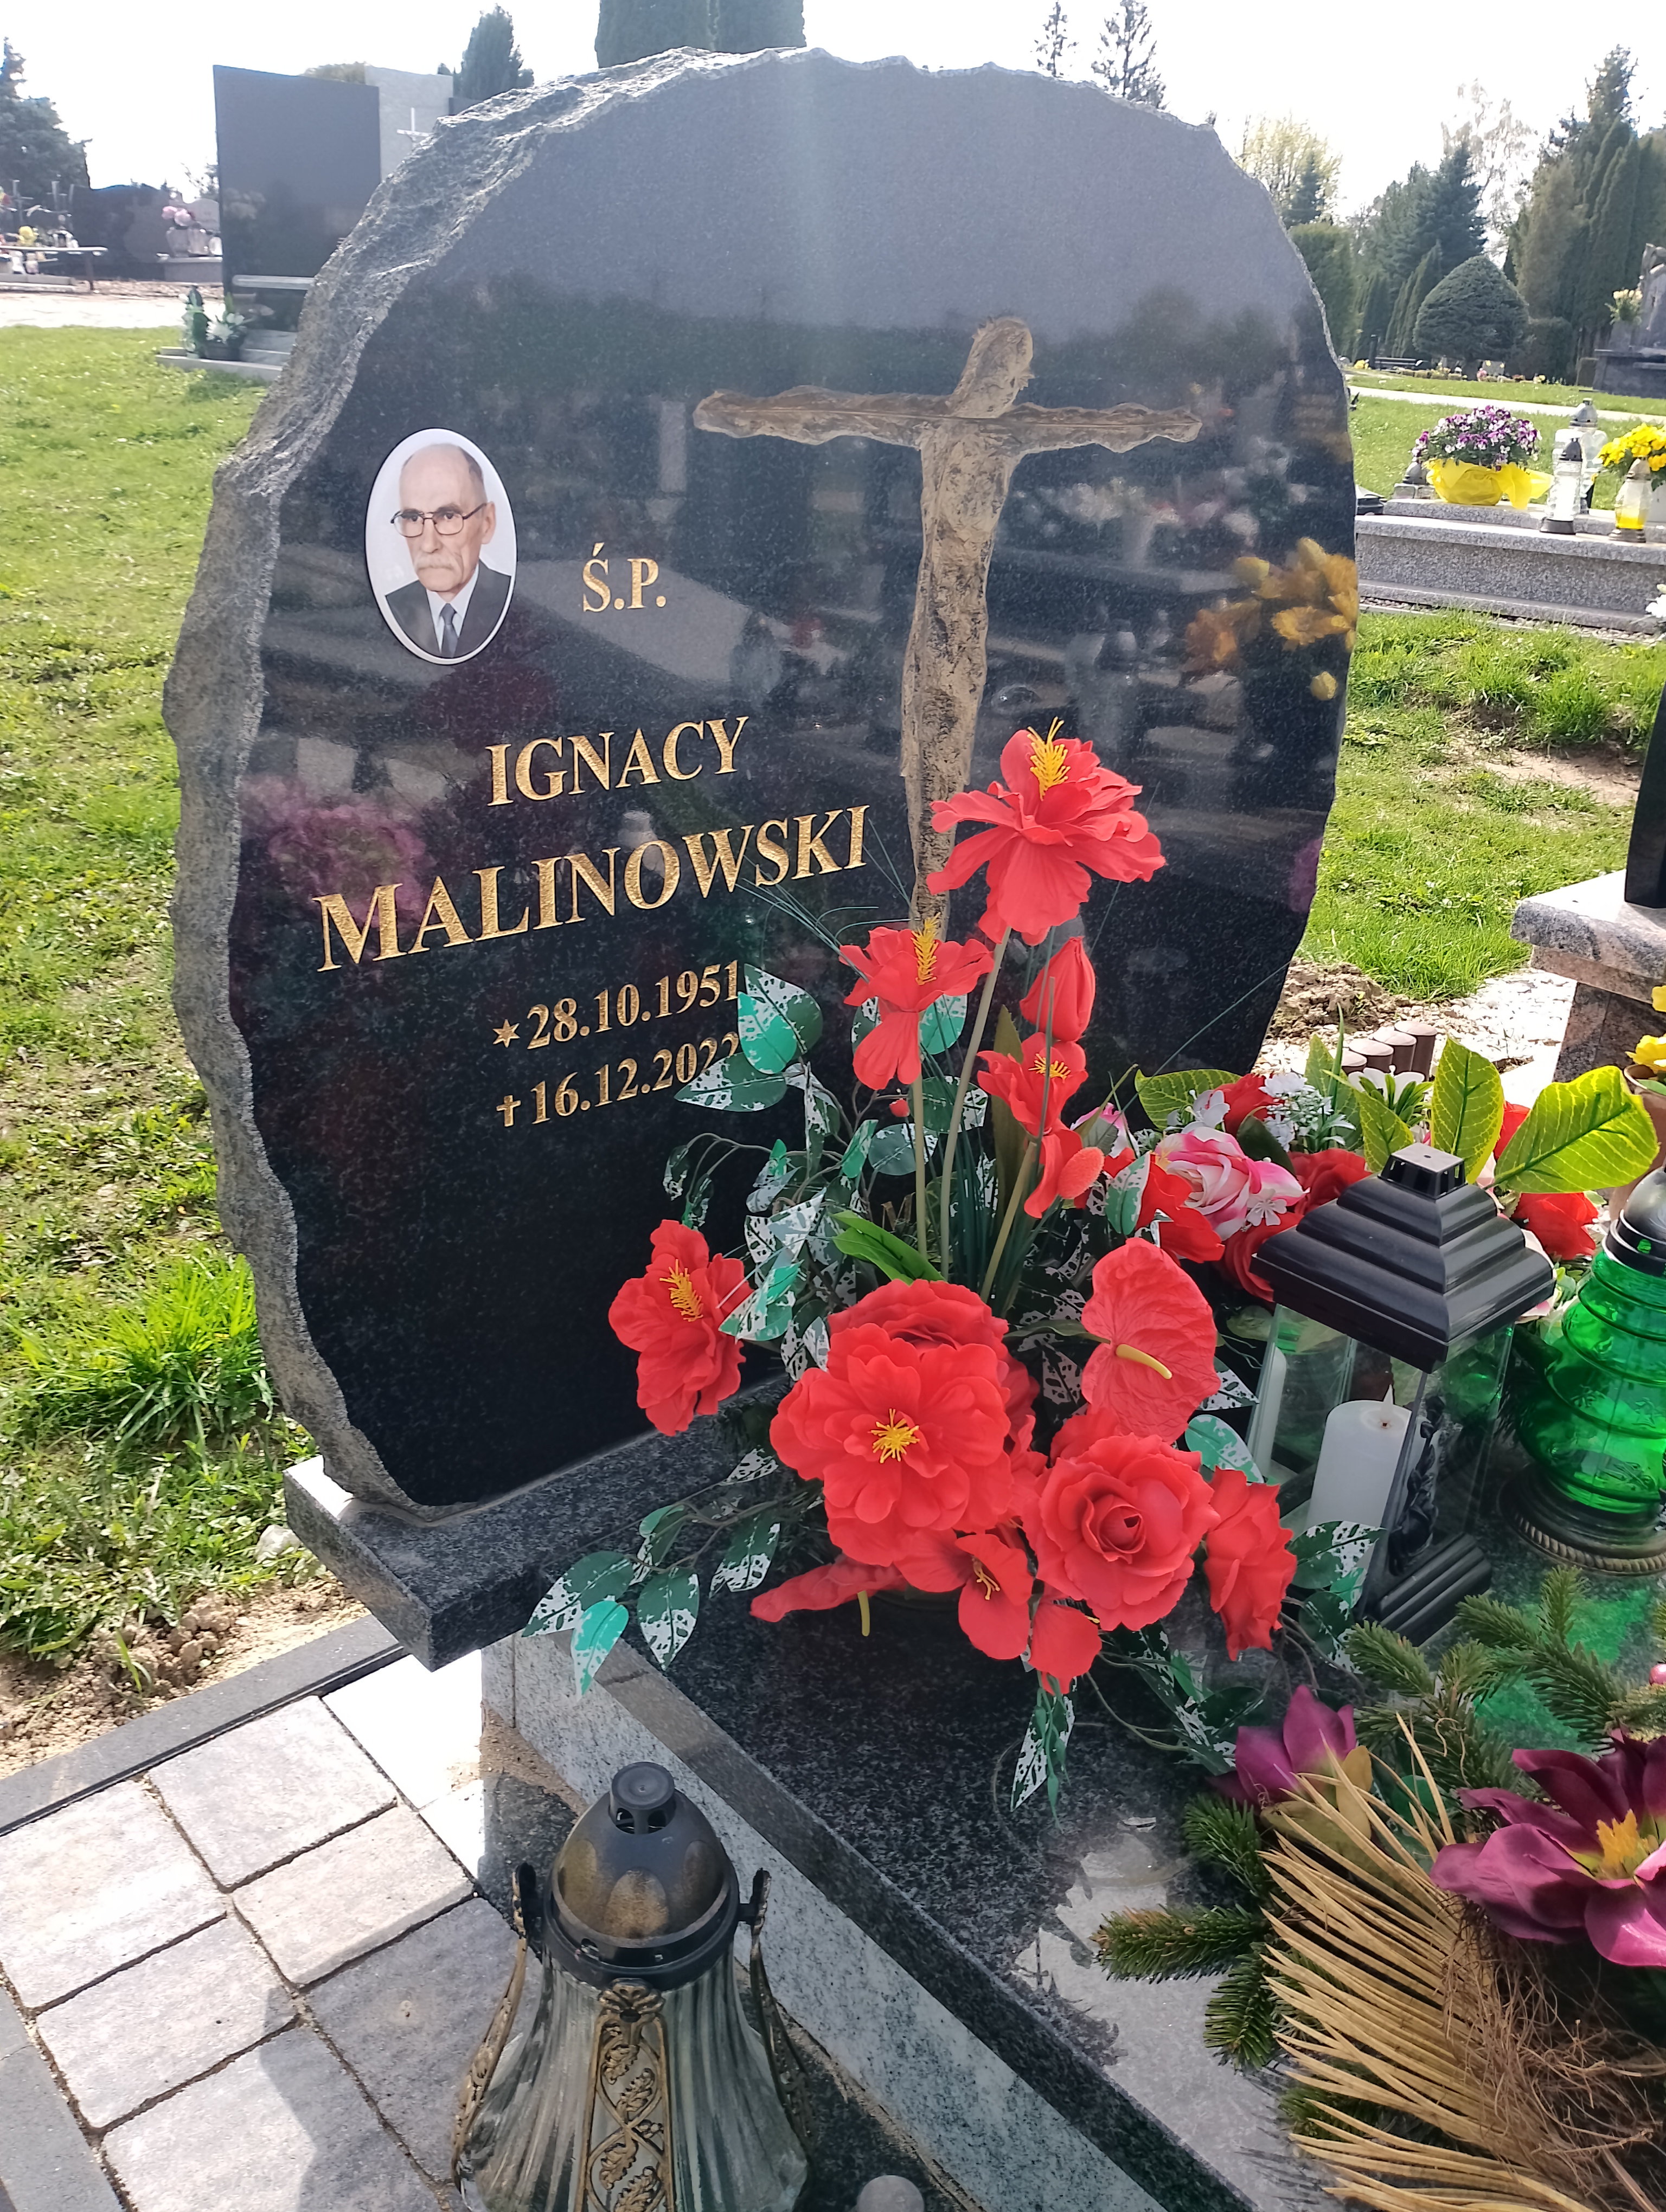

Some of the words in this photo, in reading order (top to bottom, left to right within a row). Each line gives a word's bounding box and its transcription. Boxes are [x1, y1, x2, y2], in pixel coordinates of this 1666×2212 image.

[582, 542, 667, 613] Ś.P.
[485, 716, 749, 807] IGNACY
[311, 805, 869, 972] MALINOWSKI
